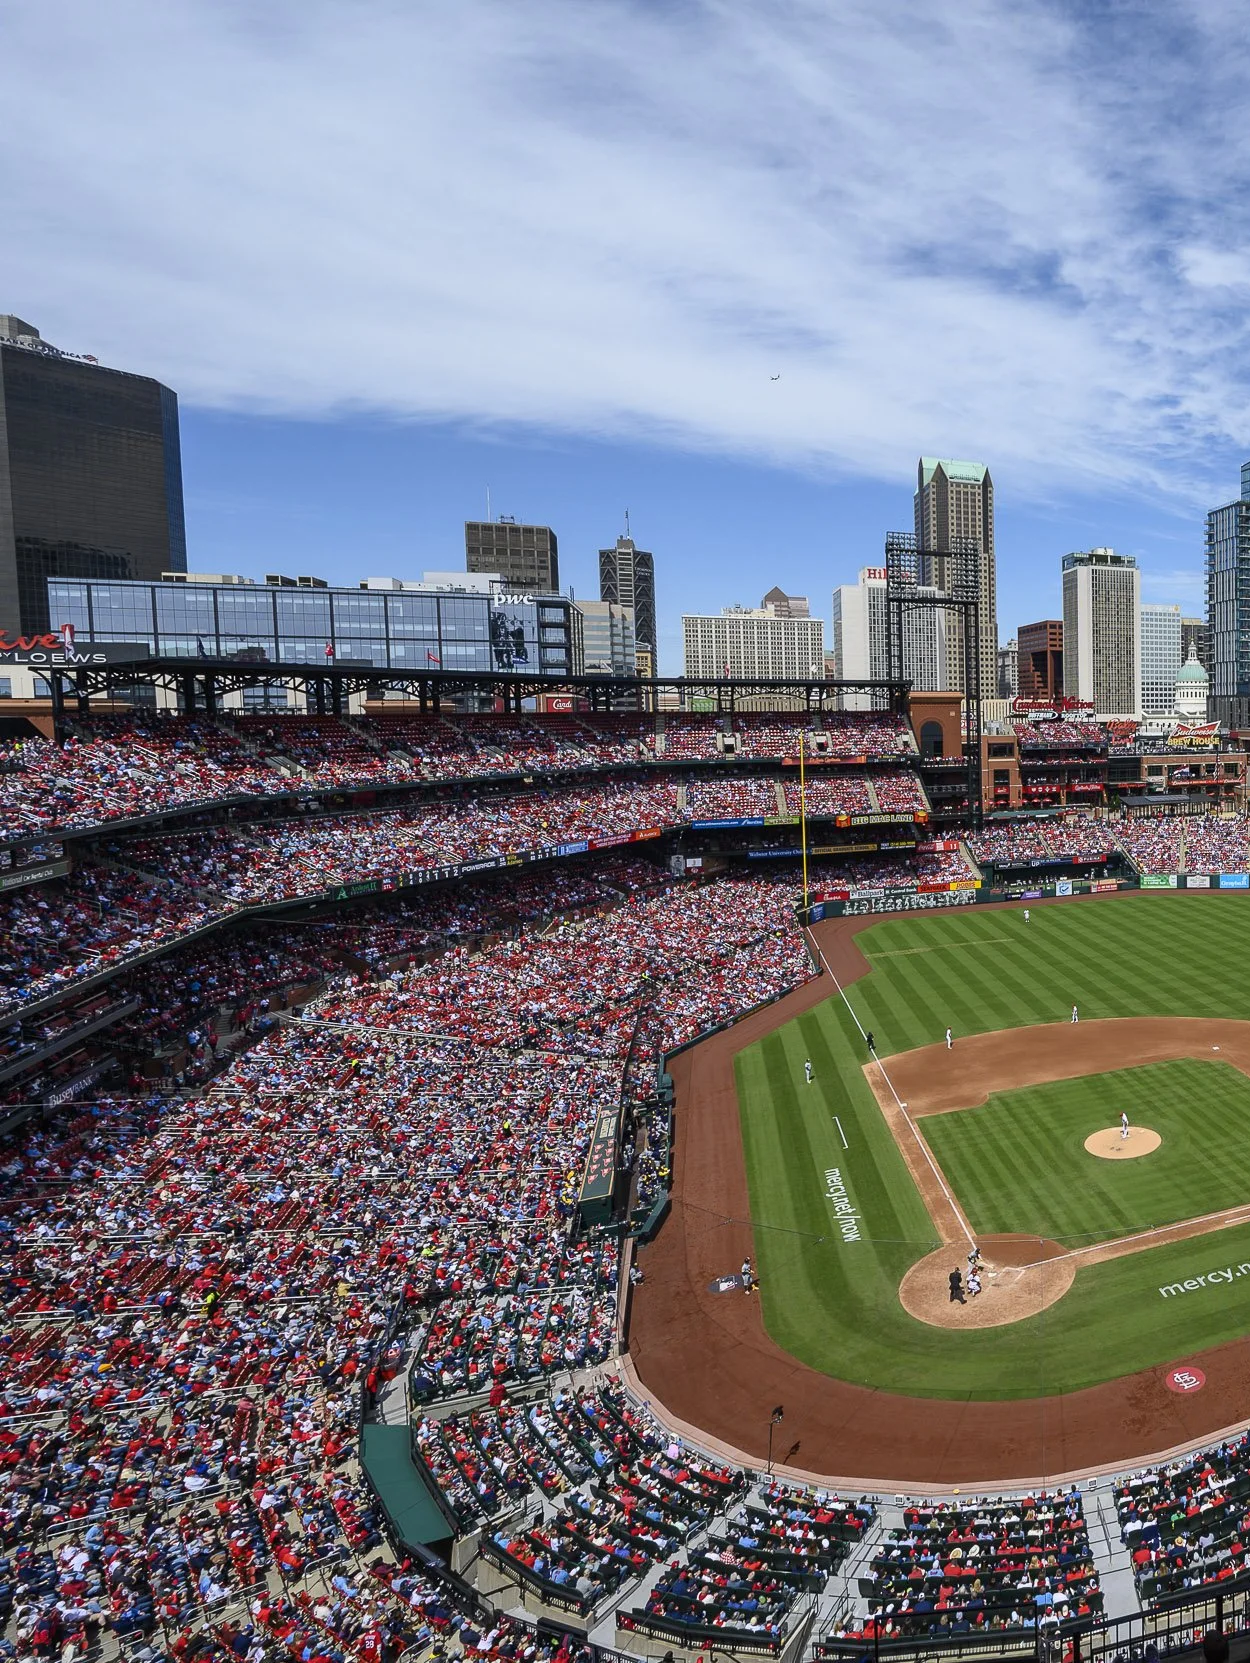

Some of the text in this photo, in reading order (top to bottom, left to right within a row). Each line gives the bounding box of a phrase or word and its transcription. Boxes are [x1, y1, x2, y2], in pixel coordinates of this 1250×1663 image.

[493, 591, 534, 608] pwc
[14, 652, 107, 663] LOEWS
[1171, 727, 1217, 738] Budweiser
[1168, 738, 1191, 746] BREW
[852, 817, 868, 825] BIG
[824, 1168, 861, 1242] mercy.net/now
